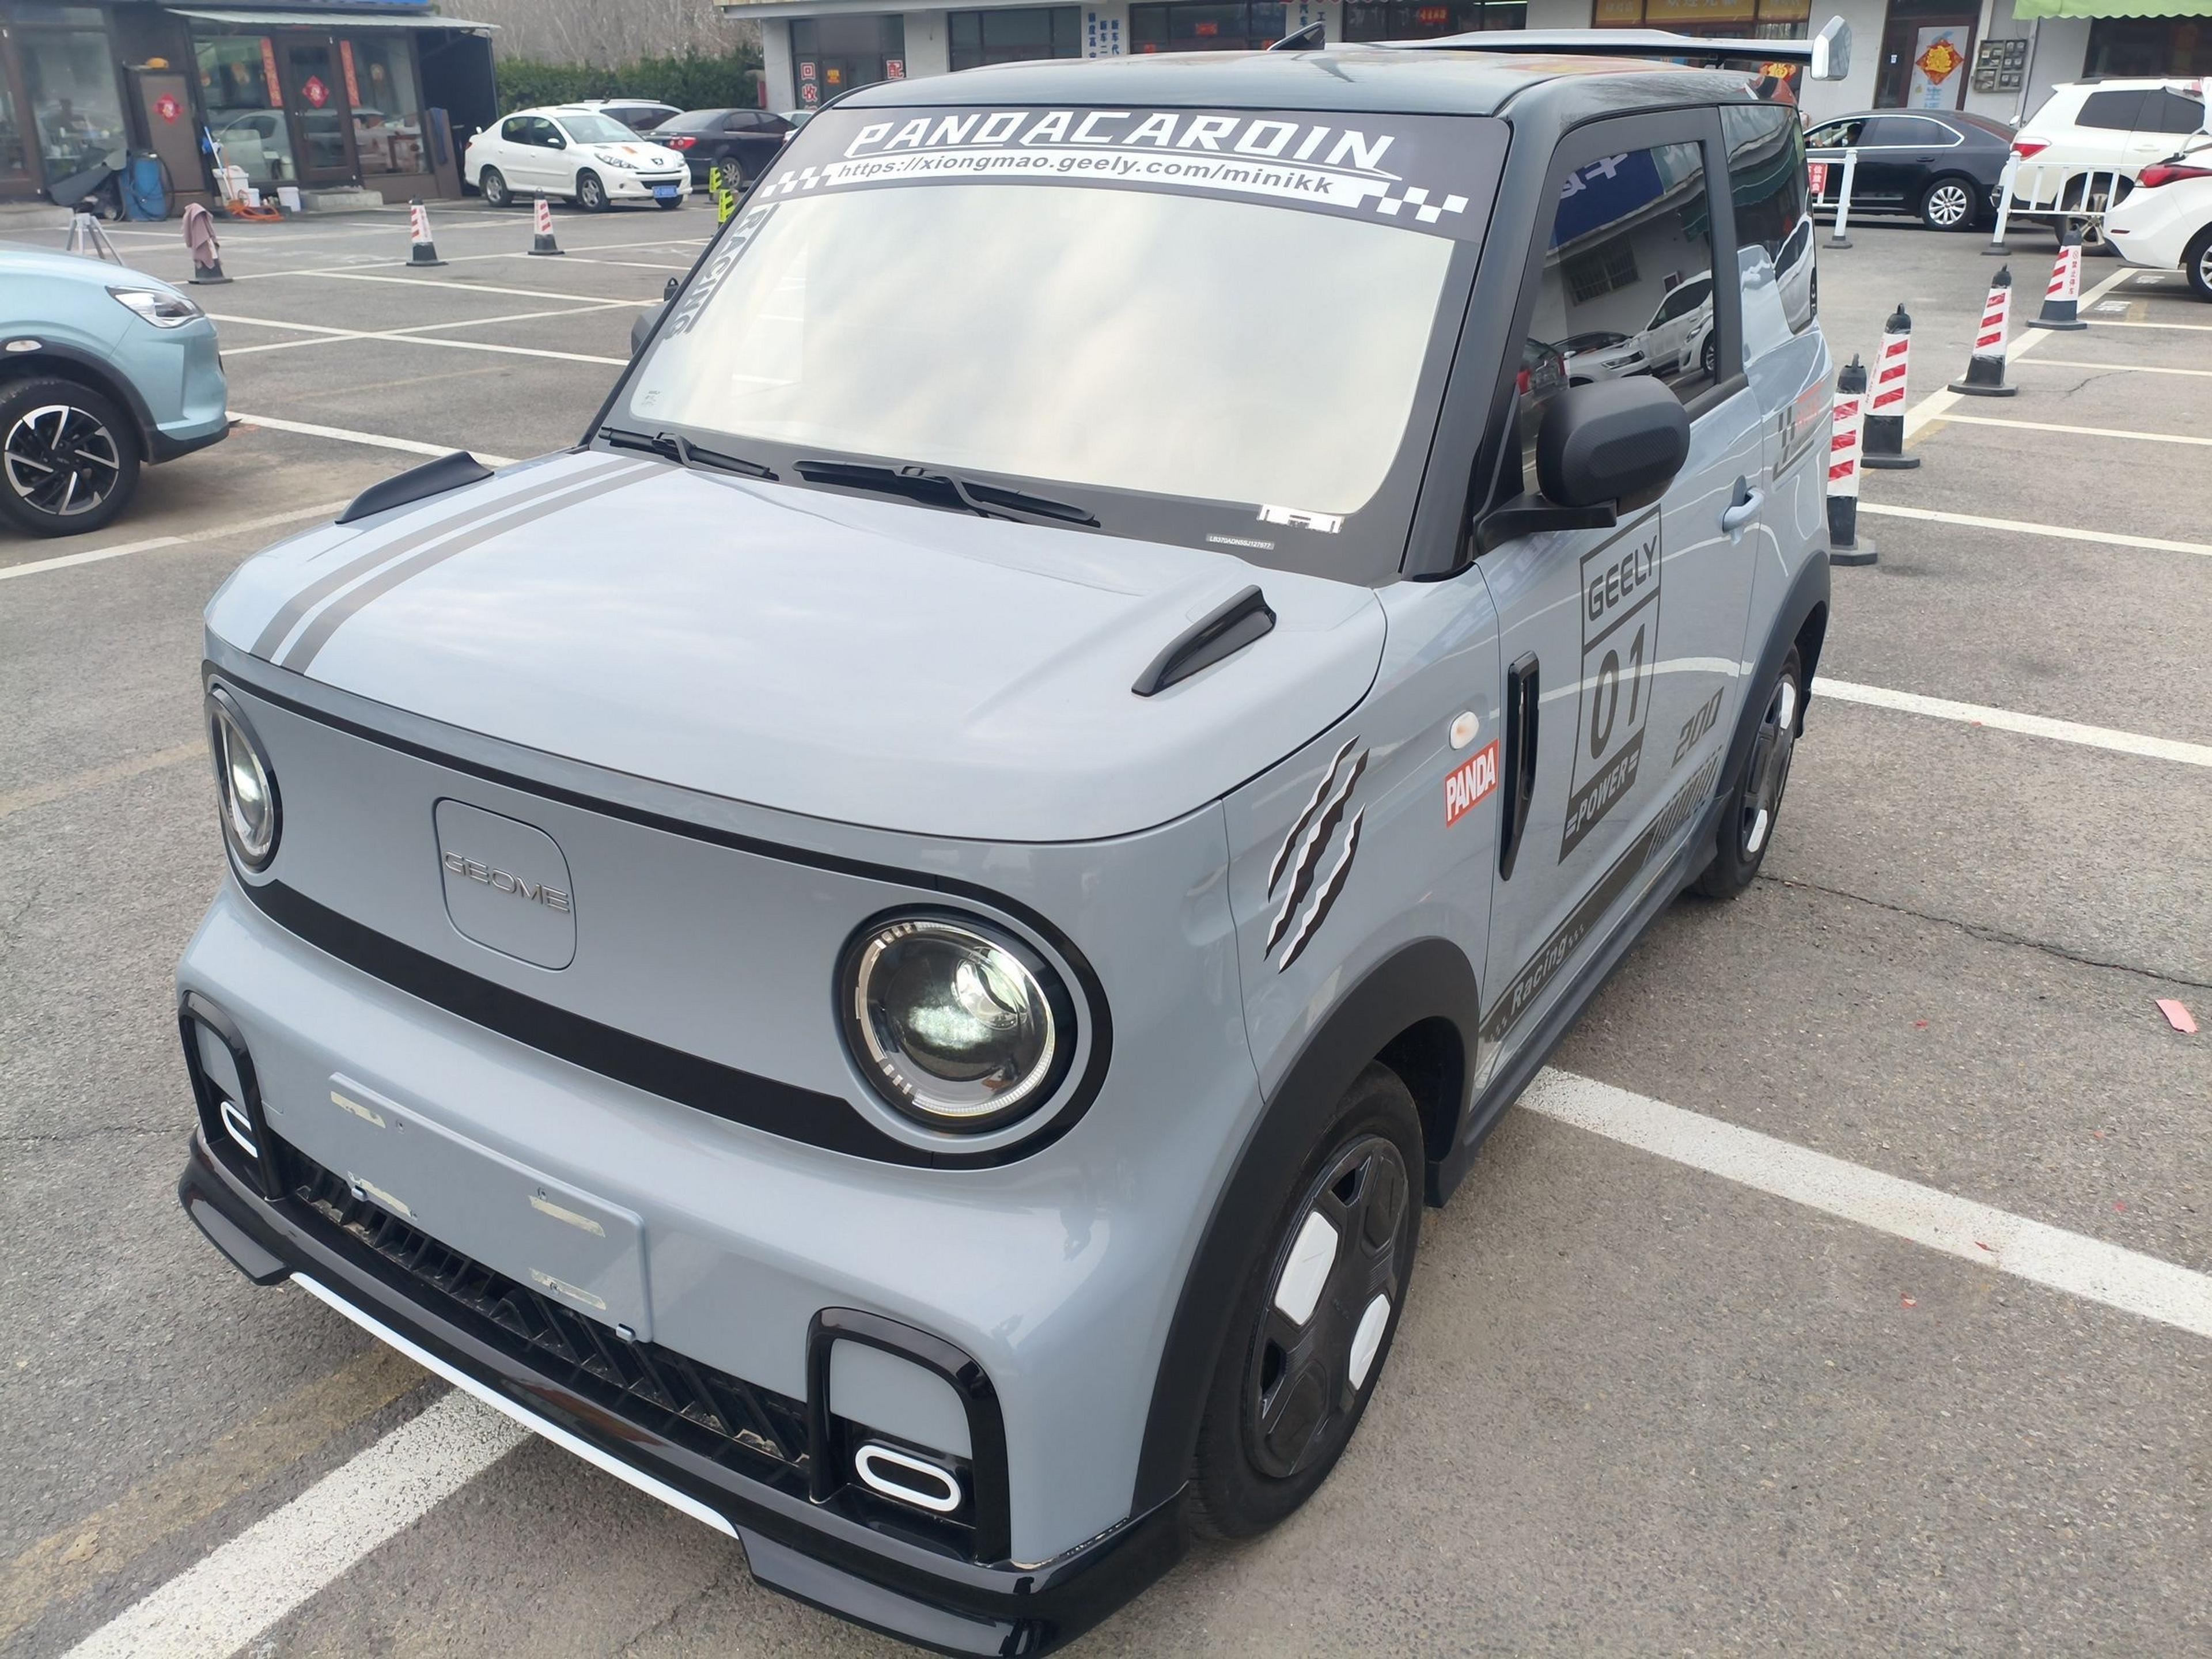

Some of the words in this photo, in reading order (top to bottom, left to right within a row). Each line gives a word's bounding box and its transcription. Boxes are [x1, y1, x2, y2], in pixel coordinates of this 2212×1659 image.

[838, 154, 1334, 194] https://xiongmao.geely.com/minikk
[1588, 535, 1657, 621] GEELY
[1590, 623, 1645, 760] 01
[1446, 747, 1496, 821] PANDA
[444, 850, 570, 914] GEOME
[1511, 935, 1568, 1016] Racing
